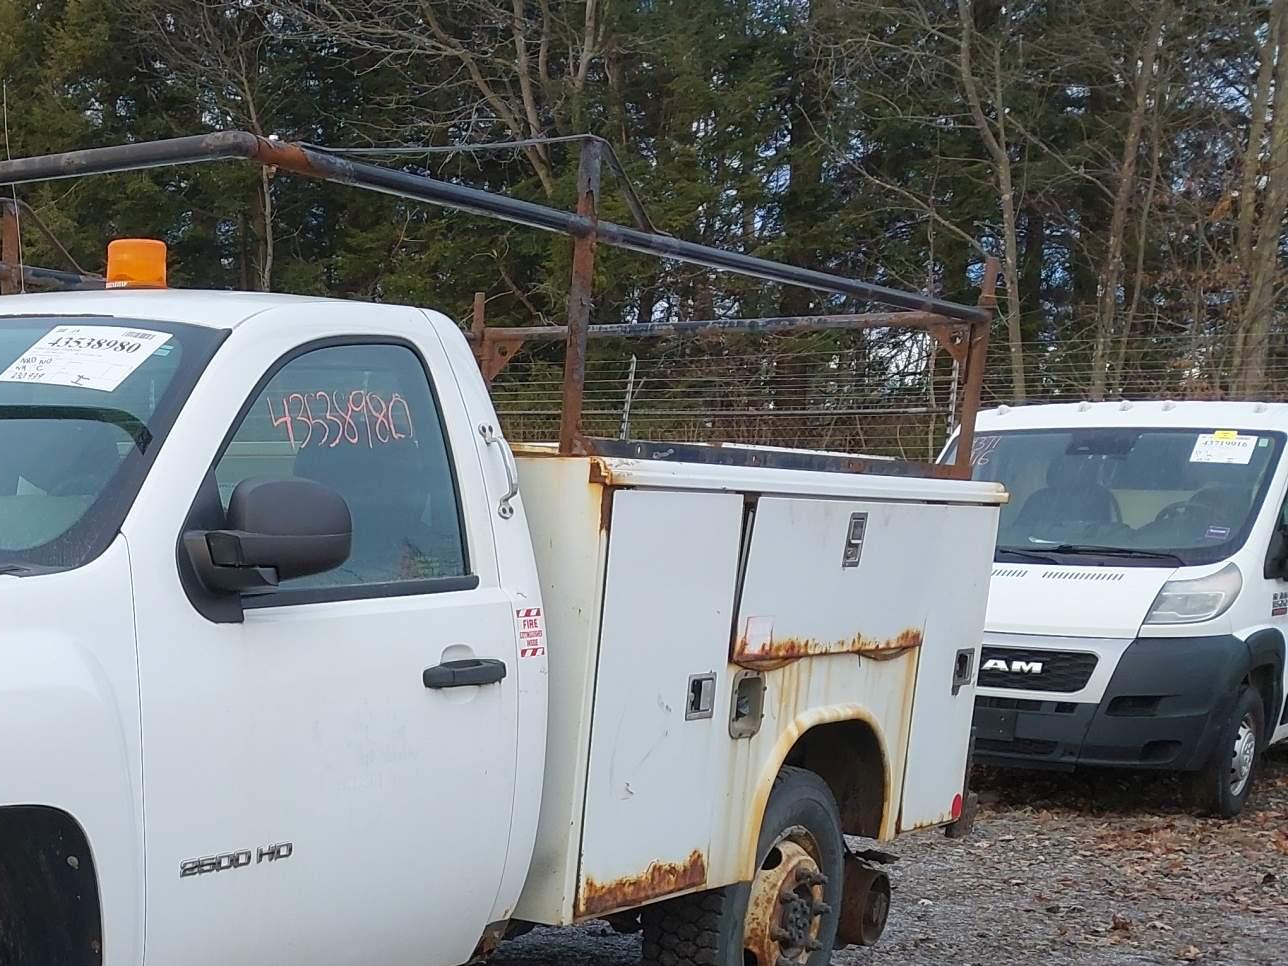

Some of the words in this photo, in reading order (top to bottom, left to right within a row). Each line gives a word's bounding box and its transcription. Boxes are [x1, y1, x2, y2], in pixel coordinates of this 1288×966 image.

[48, 336, 142, 354] 43538980
[267, 390, 414, 448] 43538980
[522, 618, 539, 630] FIRE
[980, 658, 1043, 674] AM
[179, 850, 252, 878] 2500
[256, 841, 293, 865] HD
